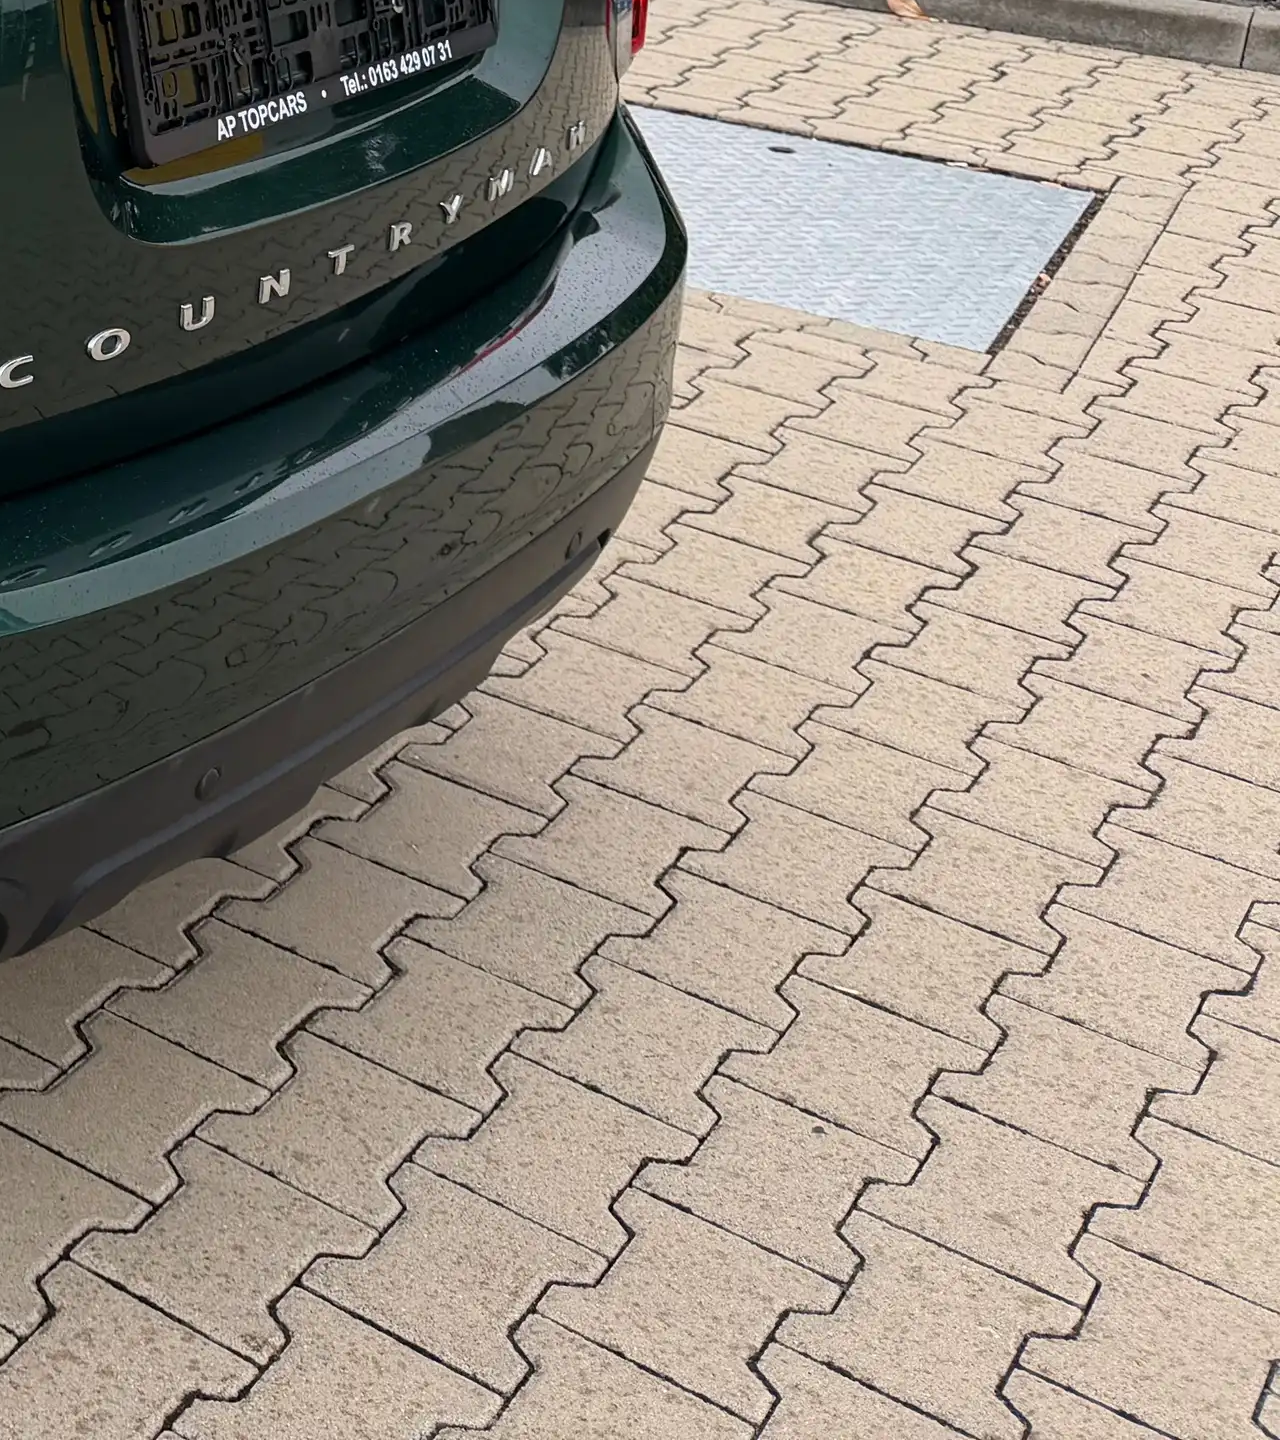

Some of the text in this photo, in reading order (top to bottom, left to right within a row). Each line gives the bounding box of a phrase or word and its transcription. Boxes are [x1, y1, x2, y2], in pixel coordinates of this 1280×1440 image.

[217, 116, 237, 141] AP
[238, 91, 308, 133] TOPCARS
[368, 60, 399, 87] 0163
[400, 51, 422, 76] 429
[421, 45, 437, 67] 07
[437, 39, 453, 61] 31
